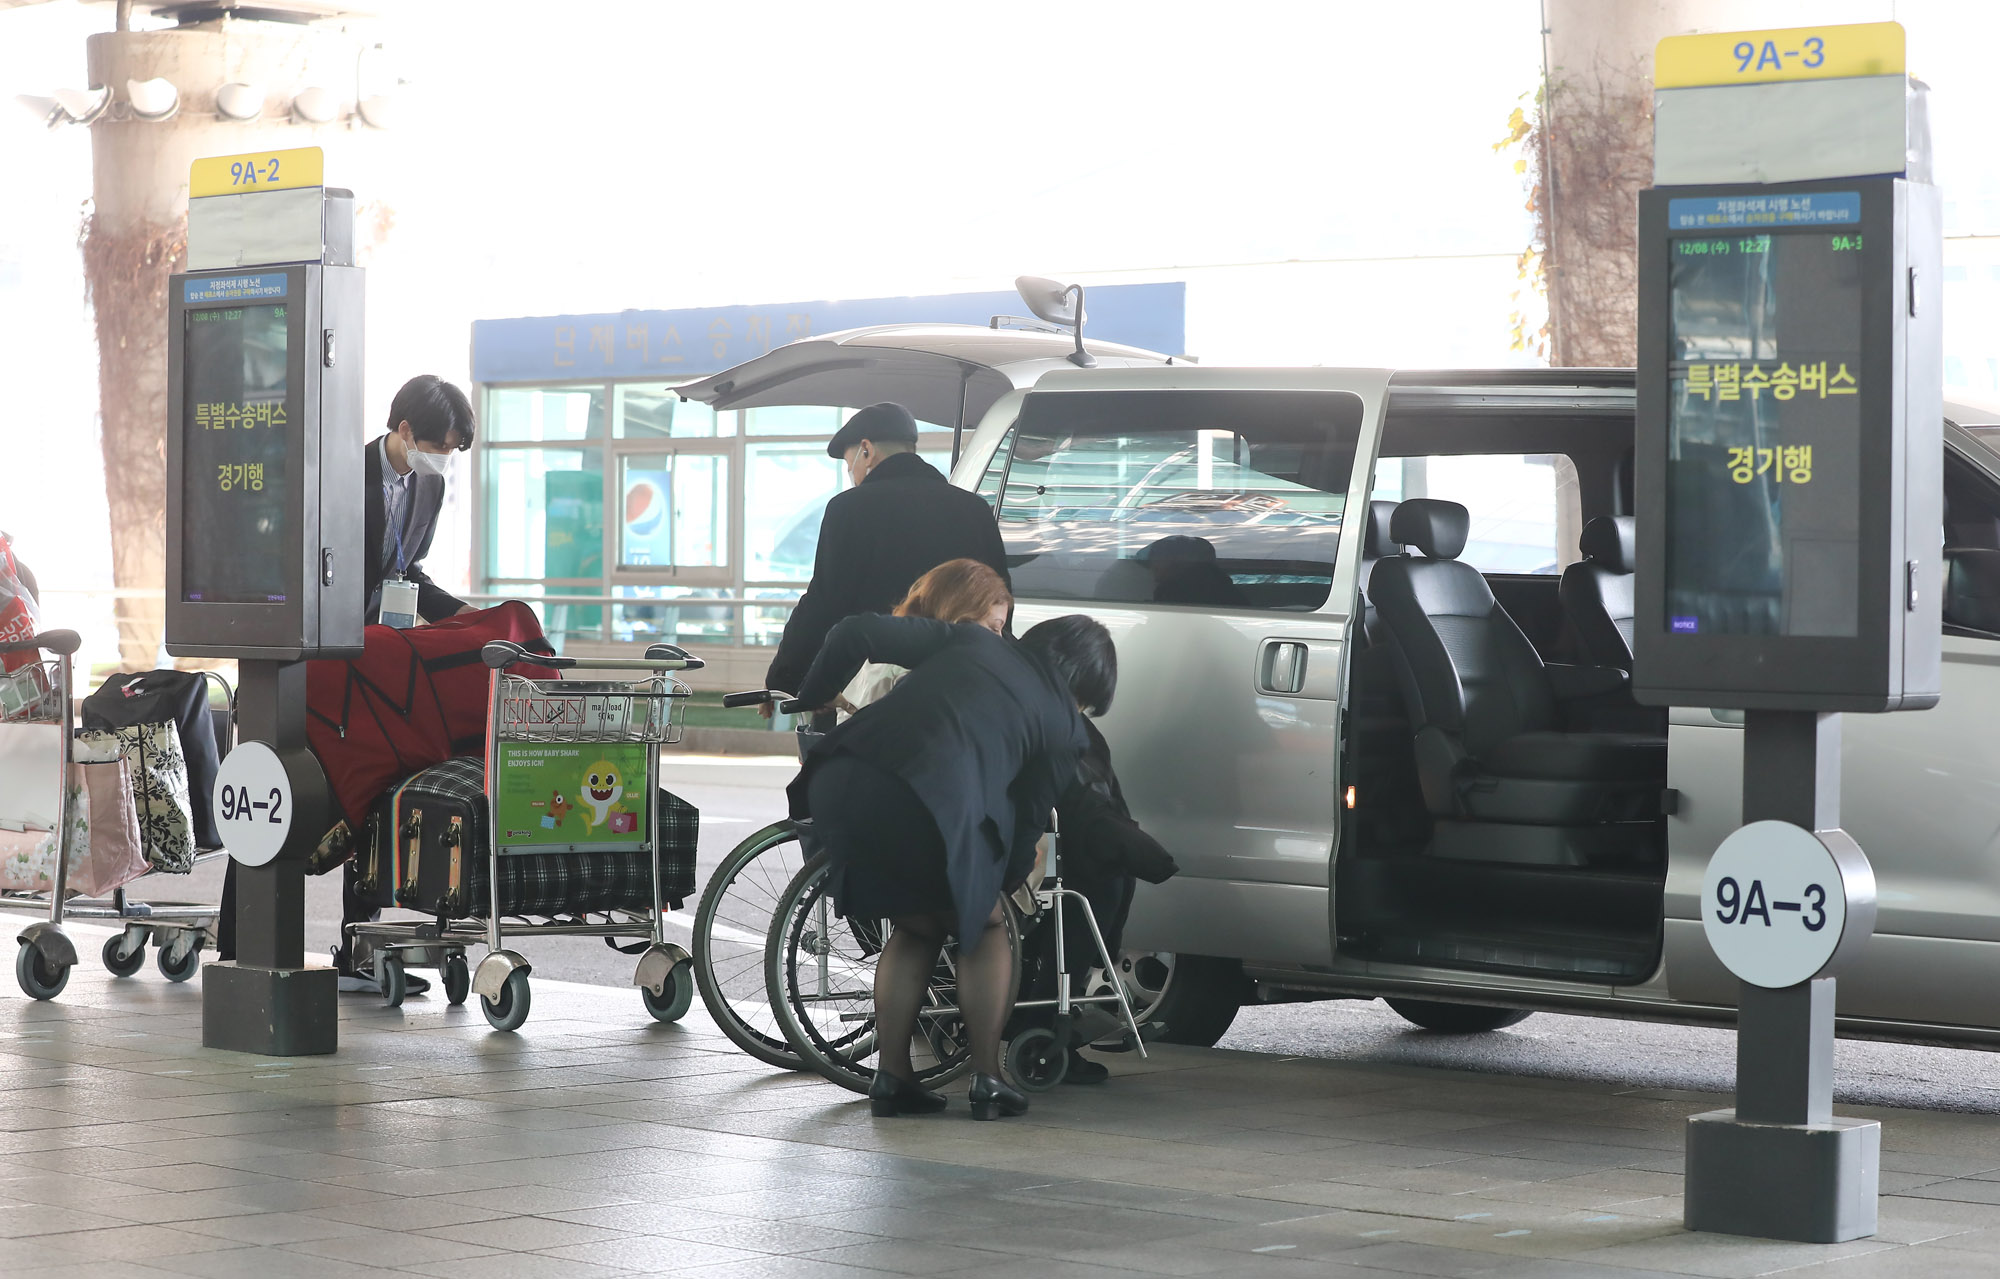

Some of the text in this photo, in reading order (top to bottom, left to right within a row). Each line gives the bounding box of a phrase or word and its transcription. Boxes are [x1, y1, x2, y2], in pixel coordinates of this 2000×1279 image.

[1733, 37, 1825, 72] 9A-3
[230, 158, 280, 185] 9A-2
[1739, 240, 1771, 253] 12:27
[1832, 235, 1863, 251] 9A-3
[554, 322, 685, 367] 단체버스
[1685, 361, 1858, 401] 특별수송버스
[195, 400, 287, 430] 특별수송버스
[218, 463, 264, 491] 경기행
[1727, 445, 1812, 484] 경기행
[608, 703, 622, 711] load
[221, 784, 282, 823] 9A-2
[1716, 876, 1826, 932] 9A-3
